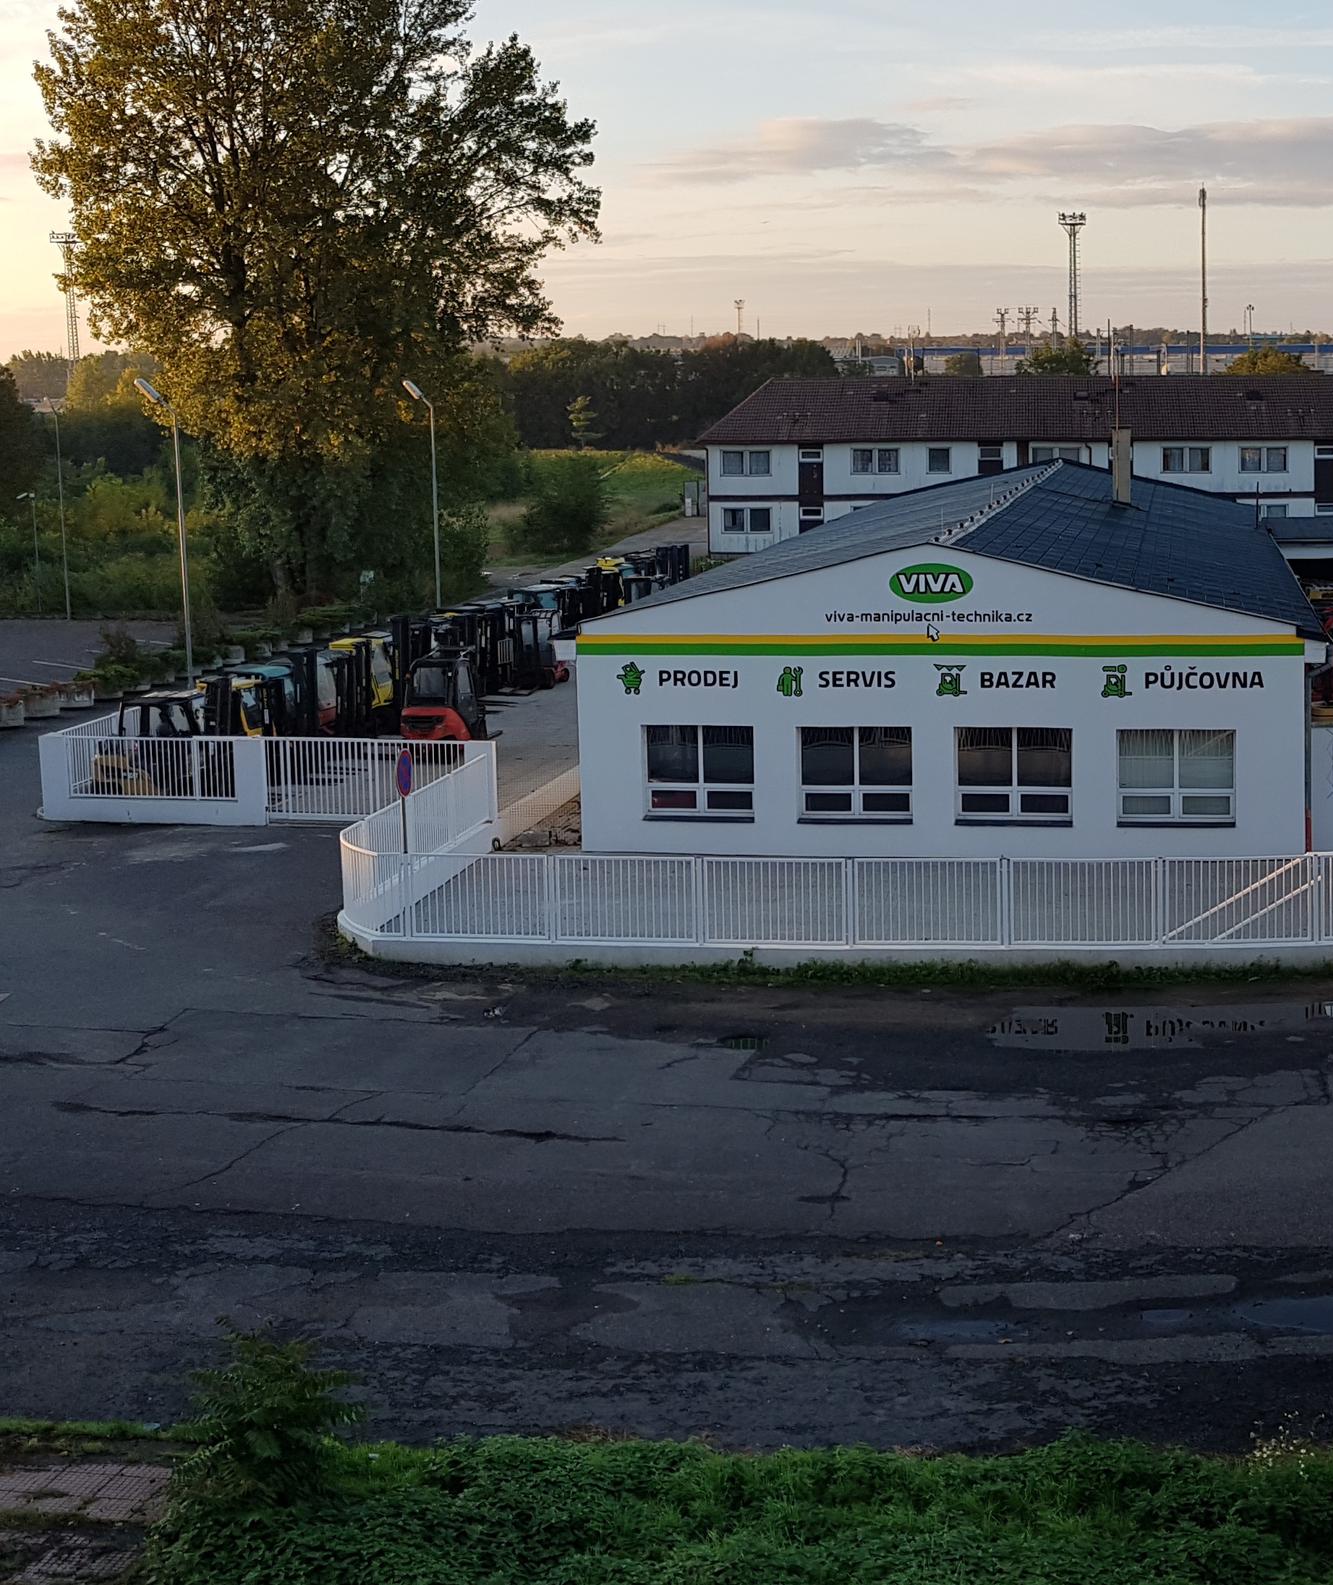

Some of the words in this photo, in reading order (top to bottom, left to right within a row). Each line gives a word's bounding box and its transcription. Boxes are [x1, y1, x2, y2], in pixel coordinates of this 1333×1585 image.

[896, 572, 967, 595] VIVA
[825, 609, 1033, 624] viva-manipulacni-technika.cz
[658, 670, 739, 689] PRODEJ
[818, 671, 896, 689] SERVIS
[980, 671, 1057, 689] BAZAR
[1144, 665, 1265, 690] PŮJČOVNA
